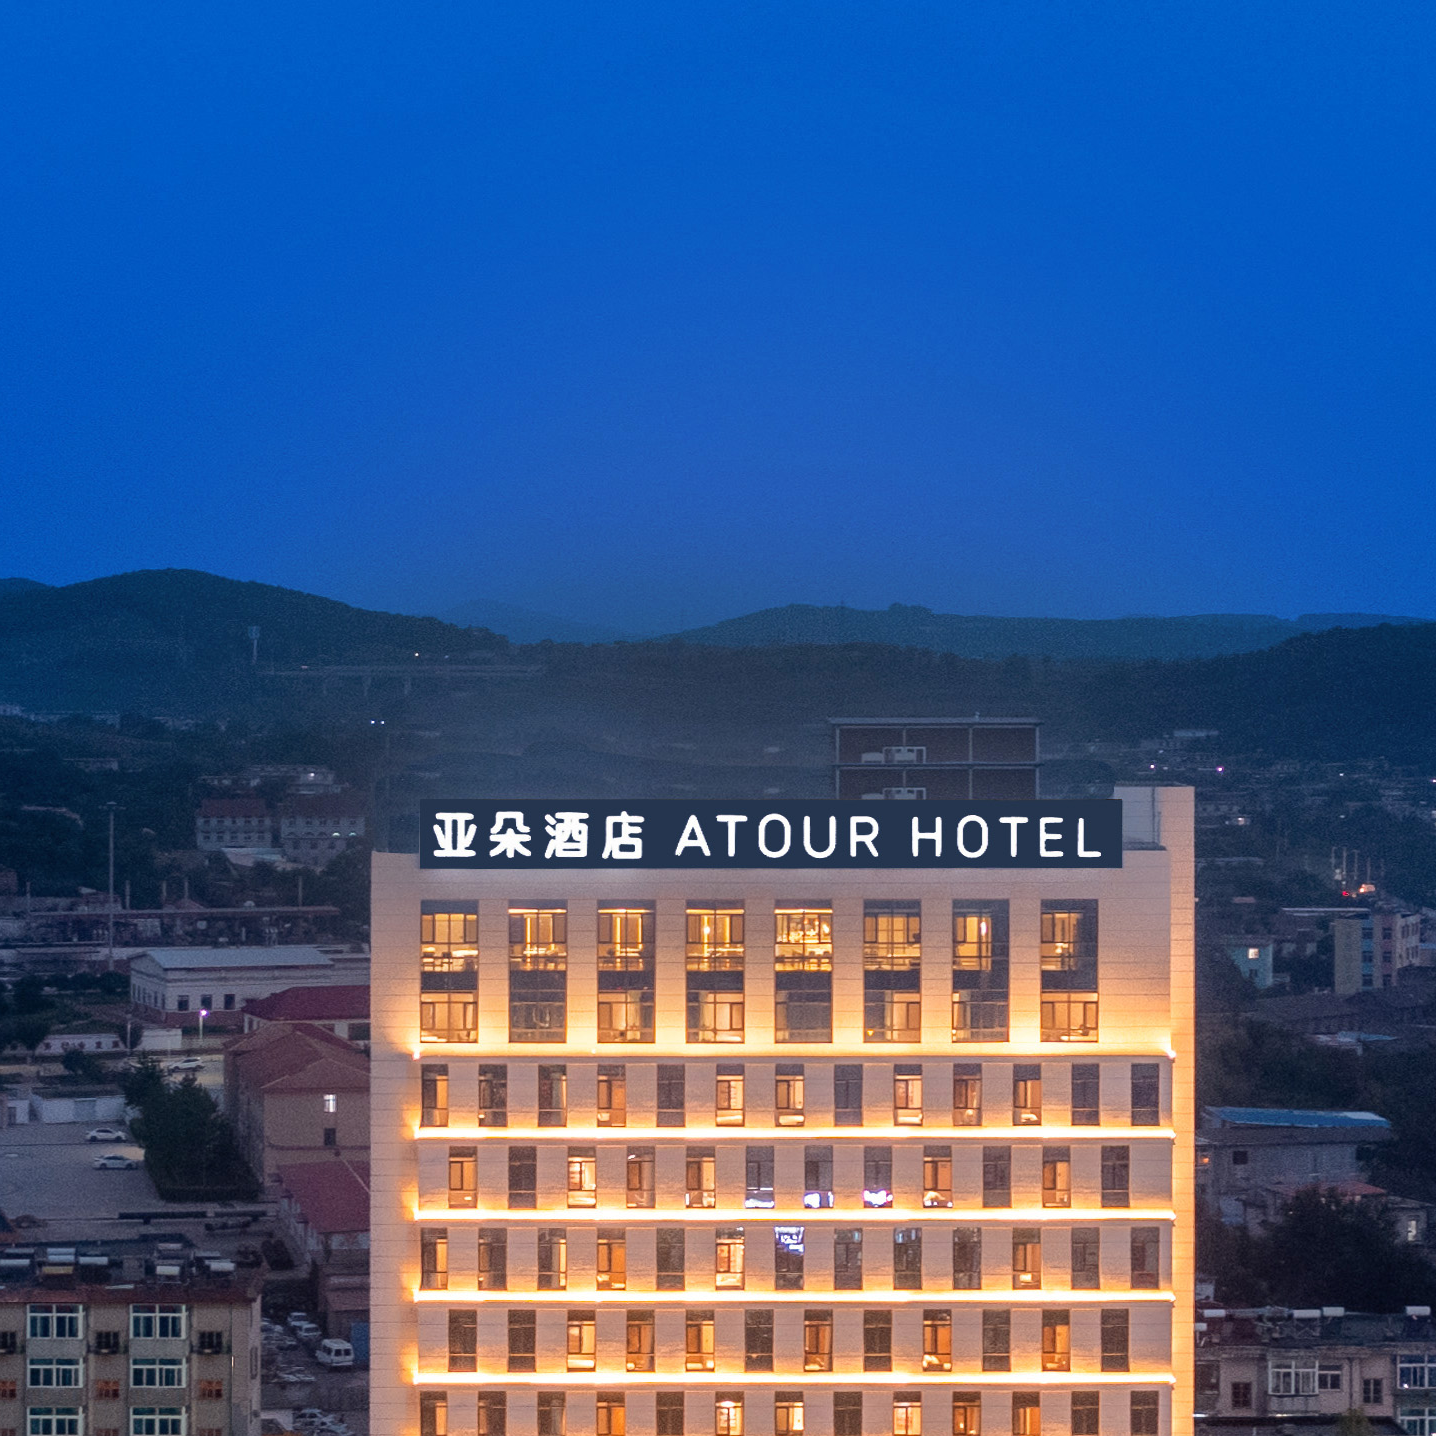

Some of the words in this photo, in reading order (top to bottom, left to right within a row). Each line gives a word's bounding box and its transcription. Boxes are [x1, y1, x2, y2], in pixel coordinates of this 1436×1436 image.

[431, 809, 646, 861] 亚朵酒店
[674, 811, 879, 860] ATOUR
[911, 811, 1103, 860] HOTEL
